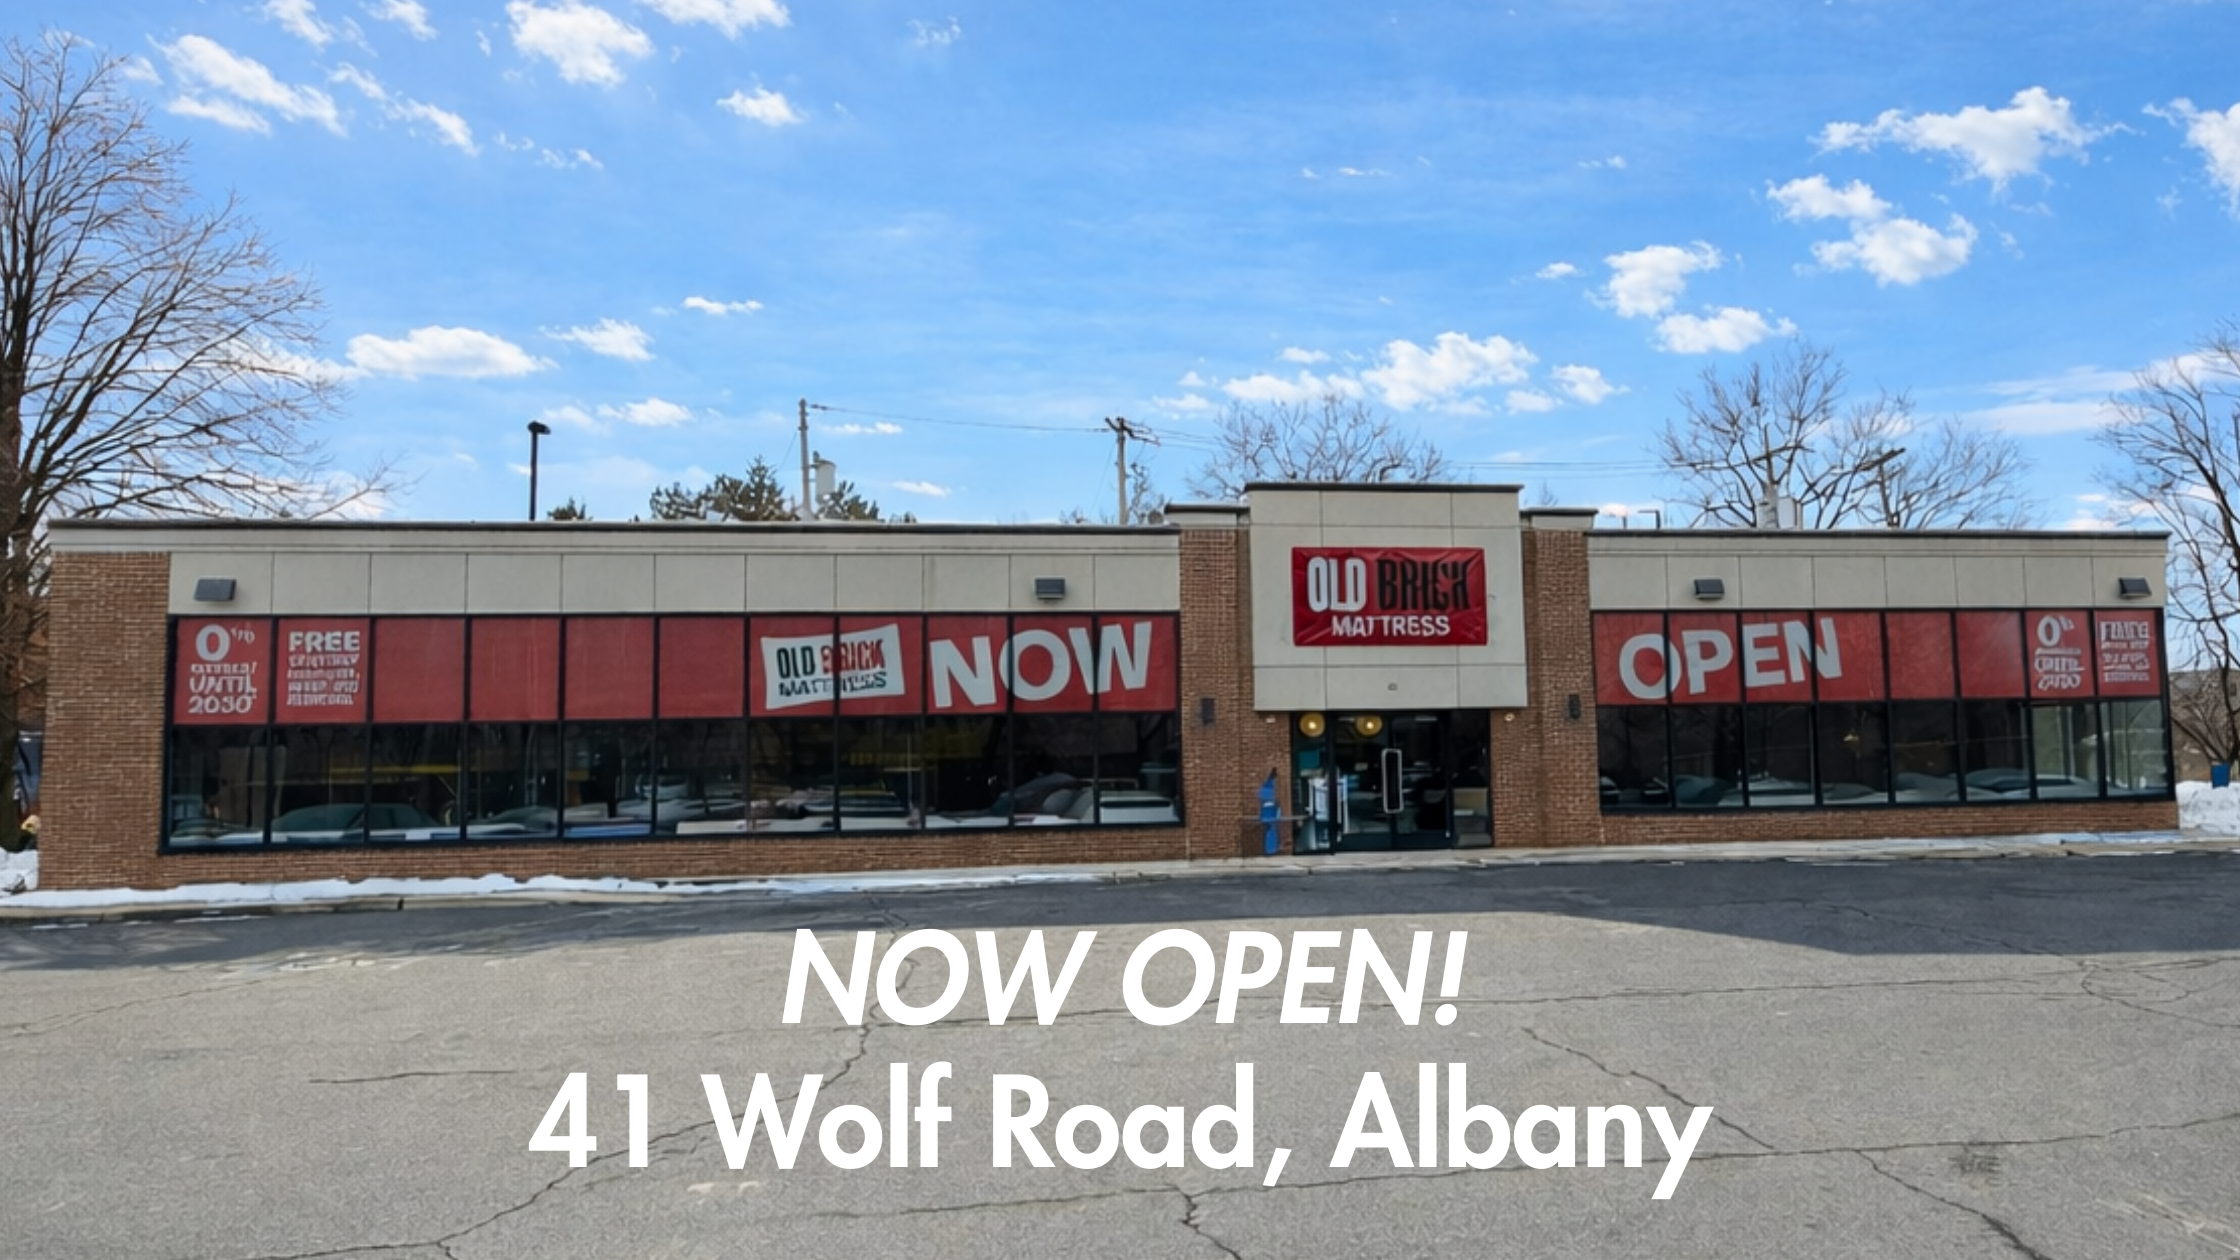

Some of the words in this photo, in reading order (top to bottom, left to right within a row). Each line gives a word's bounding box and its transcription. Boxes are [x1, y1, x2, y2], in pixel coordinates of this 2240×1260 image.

[1307, 556, 1366, 612] OLD
[1376, 558, 1471, 611] BRICK
[289, 631, 360, 653] FREE
[1332, 615, 1451, 637] MATTRESS
[776, 644, 816, 679] OLD
[930, 622, 1152, 708] NOW
[1619, 617, 1843, 699] OPEN
